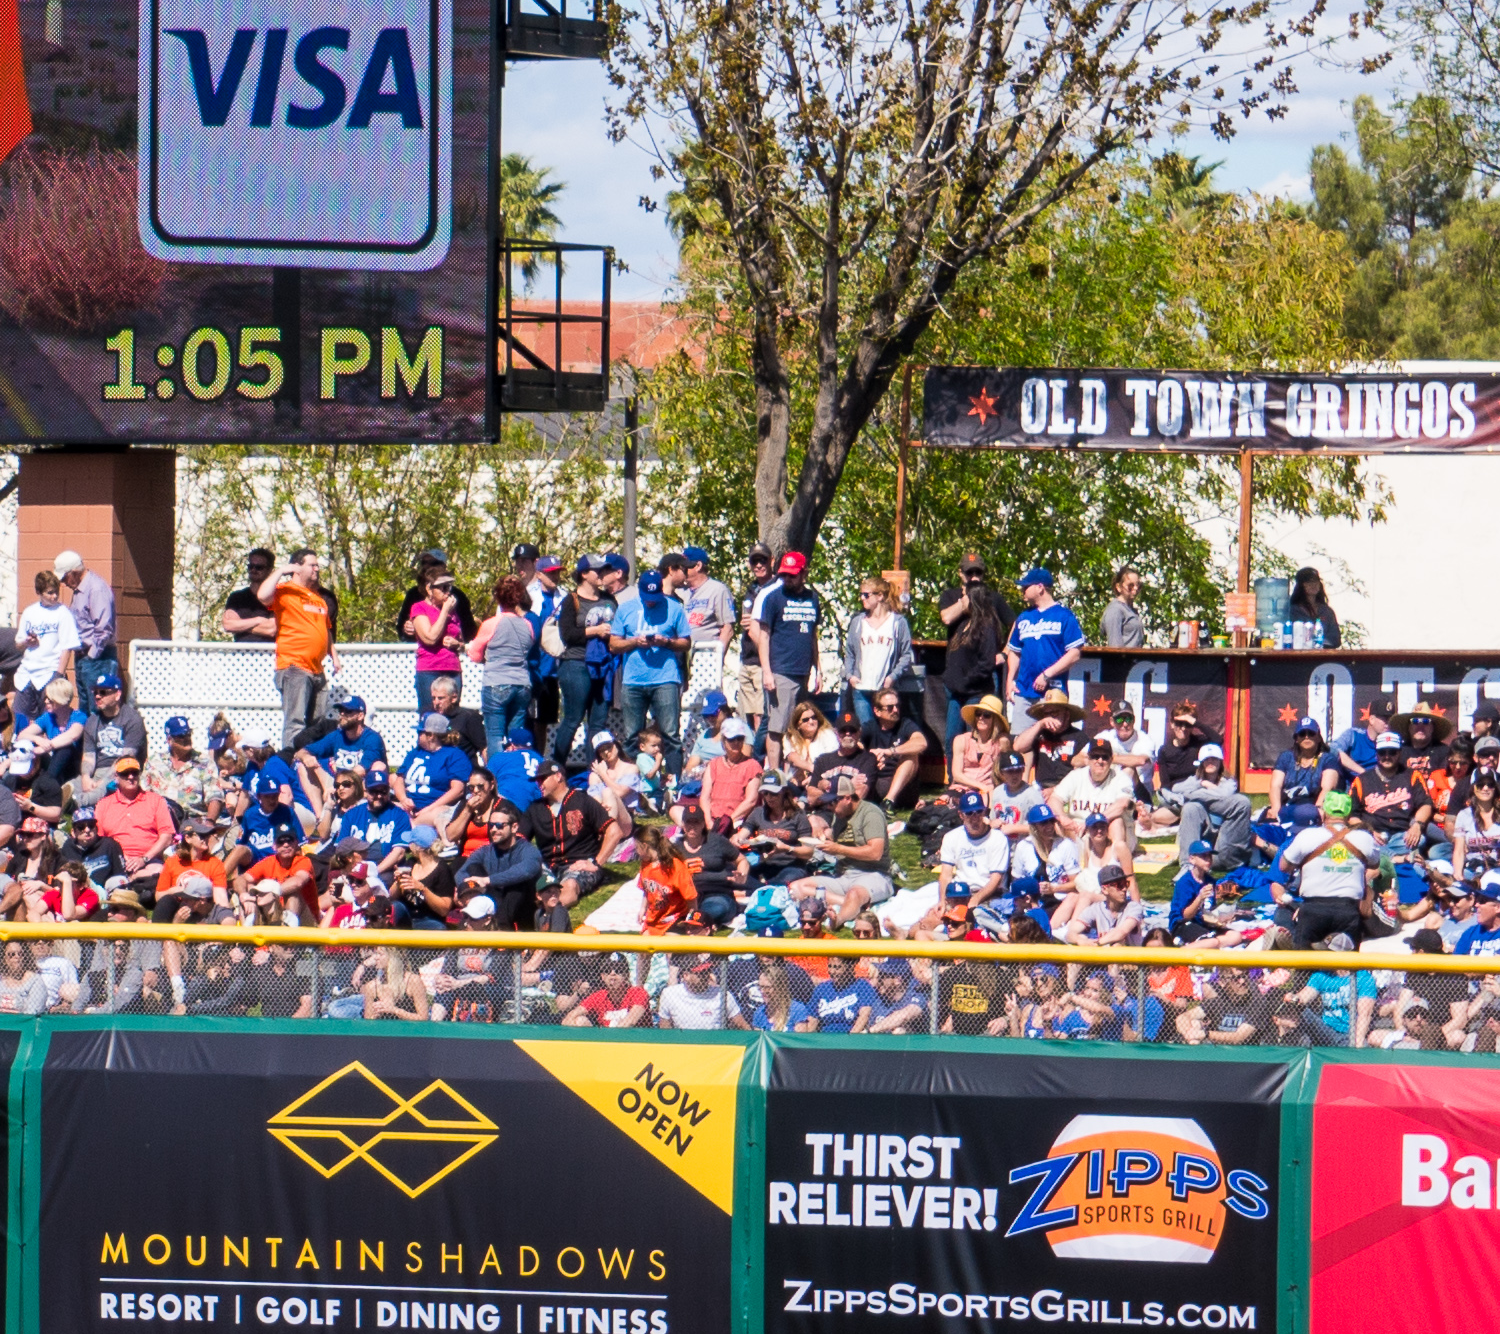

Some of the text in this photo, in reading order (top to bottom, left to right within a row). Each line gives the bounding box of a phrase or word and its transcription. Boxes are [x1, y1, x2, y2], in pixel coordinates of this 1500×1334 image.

[162, 24, 426, 130] VISA
[101, 325, 445, 403] 1:05 PM
[1021, 377, 1478, 440] OLD TOWN GRINGOS
[1017, 617, 1063, 641] Dodgers
[633, 1062, 712, 1125] NOW
[616, 1087, 695, 1159] OPEN
[805, 1132, 960, 1180] THIRST
[768, 1181, 998, 1232] RELIEVER!
[1083, 1204, 1217, 1237] SPORTS GRILL
[100, 1292, 219, 1323] RESORT
[256, 1296, 342, 1327] GOLF
[376, 1300, 501, 1333] DINING
